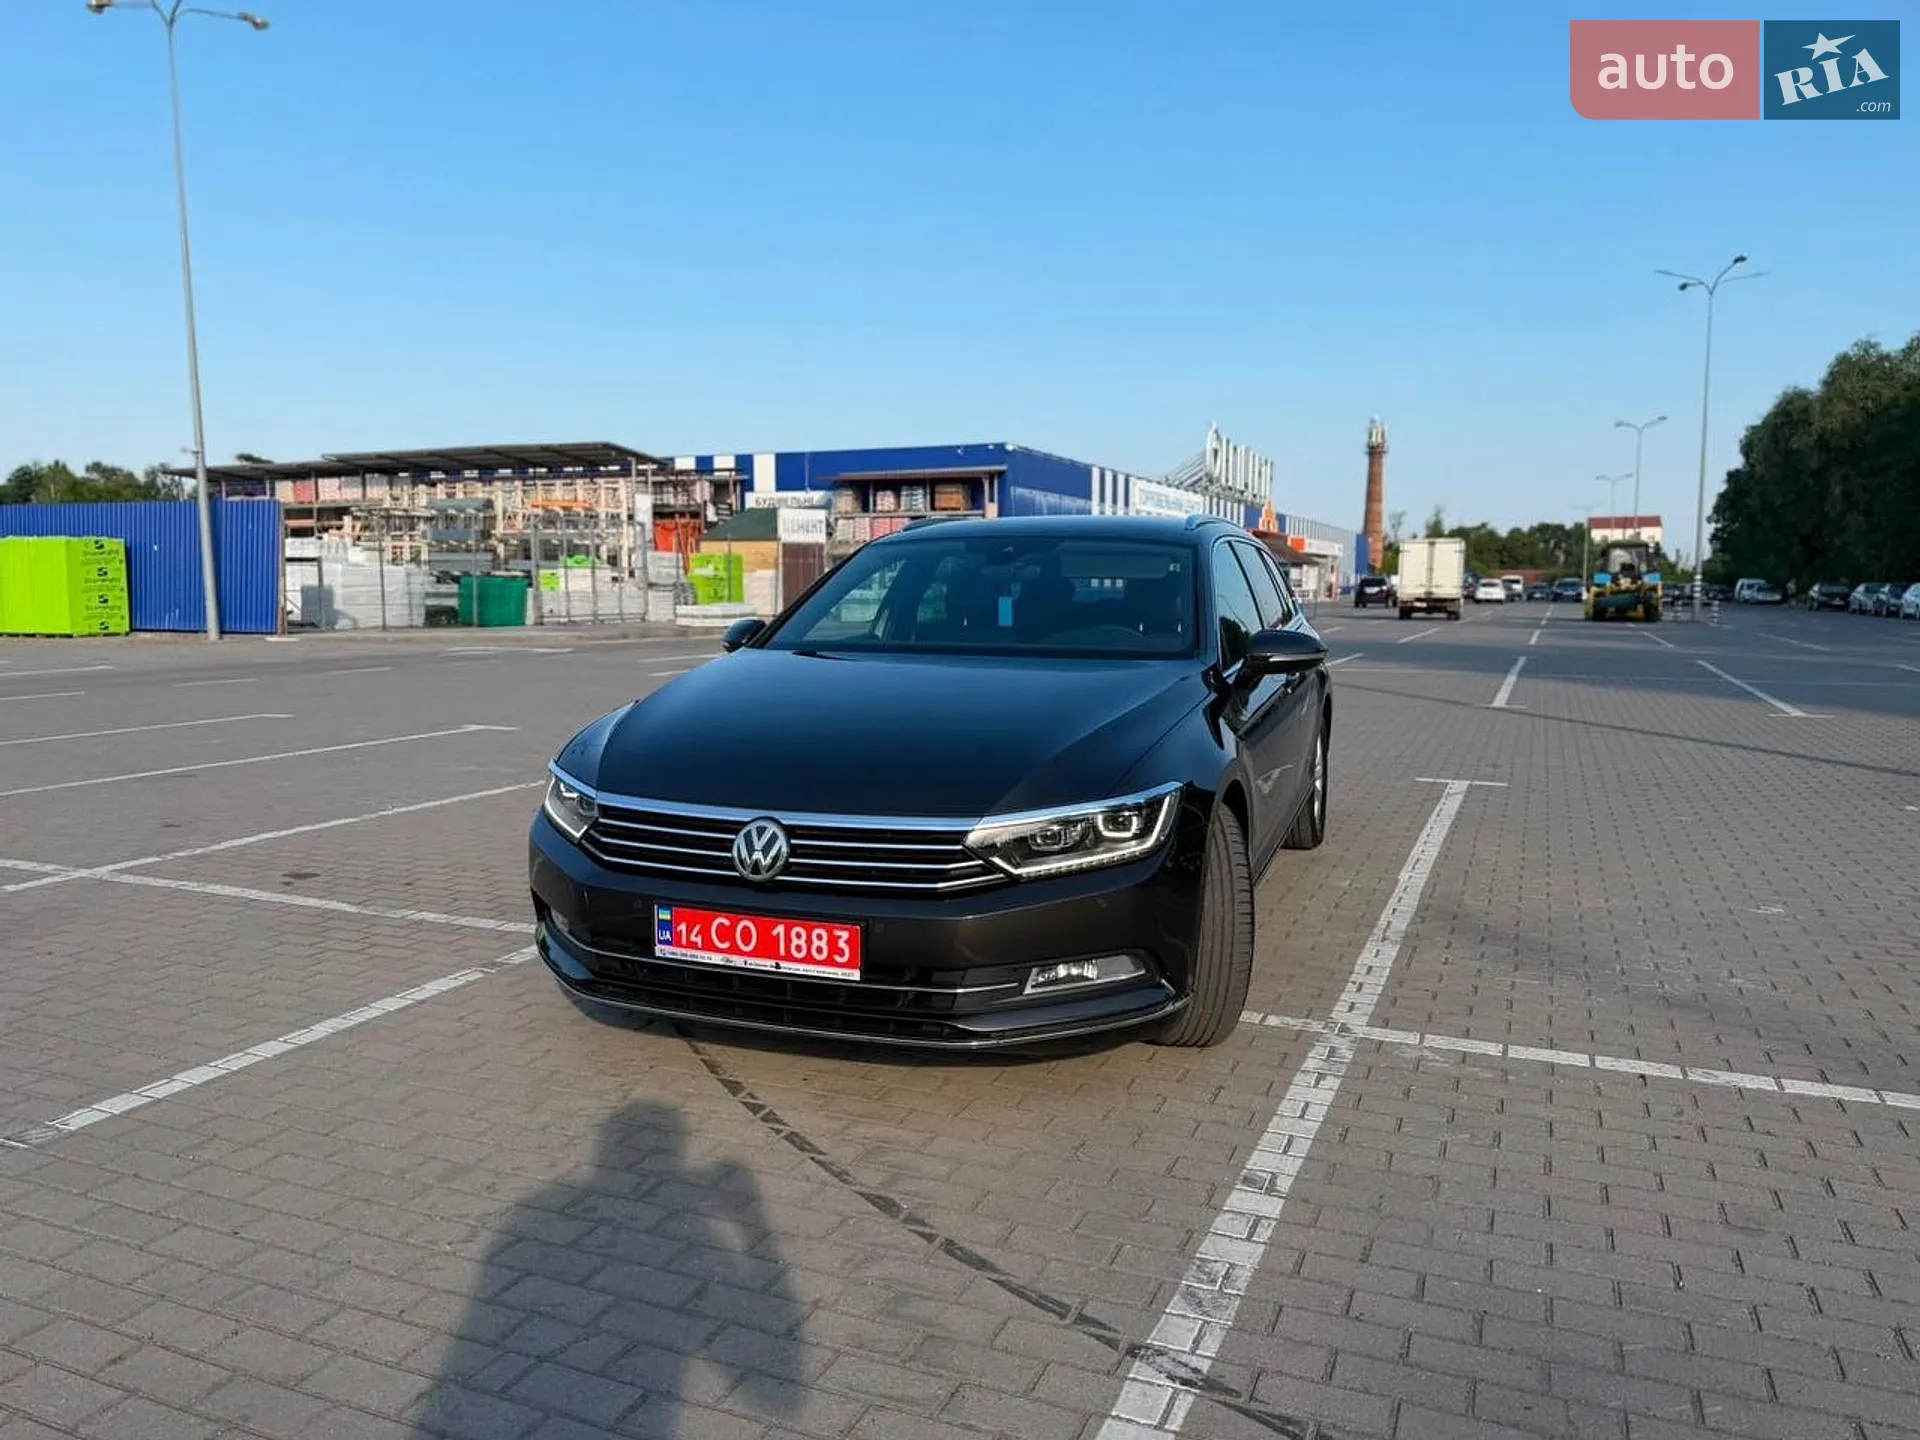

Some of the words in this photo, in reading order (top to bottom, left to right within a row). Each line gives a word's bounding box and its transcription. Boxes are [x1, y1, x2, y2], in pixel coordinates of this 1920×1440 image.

[659, 930, 671, 942] UA
[677, 922, 702, 948] 14
[711, 918, 757, 952] CO
[771, 924, 850, 963] 1883
